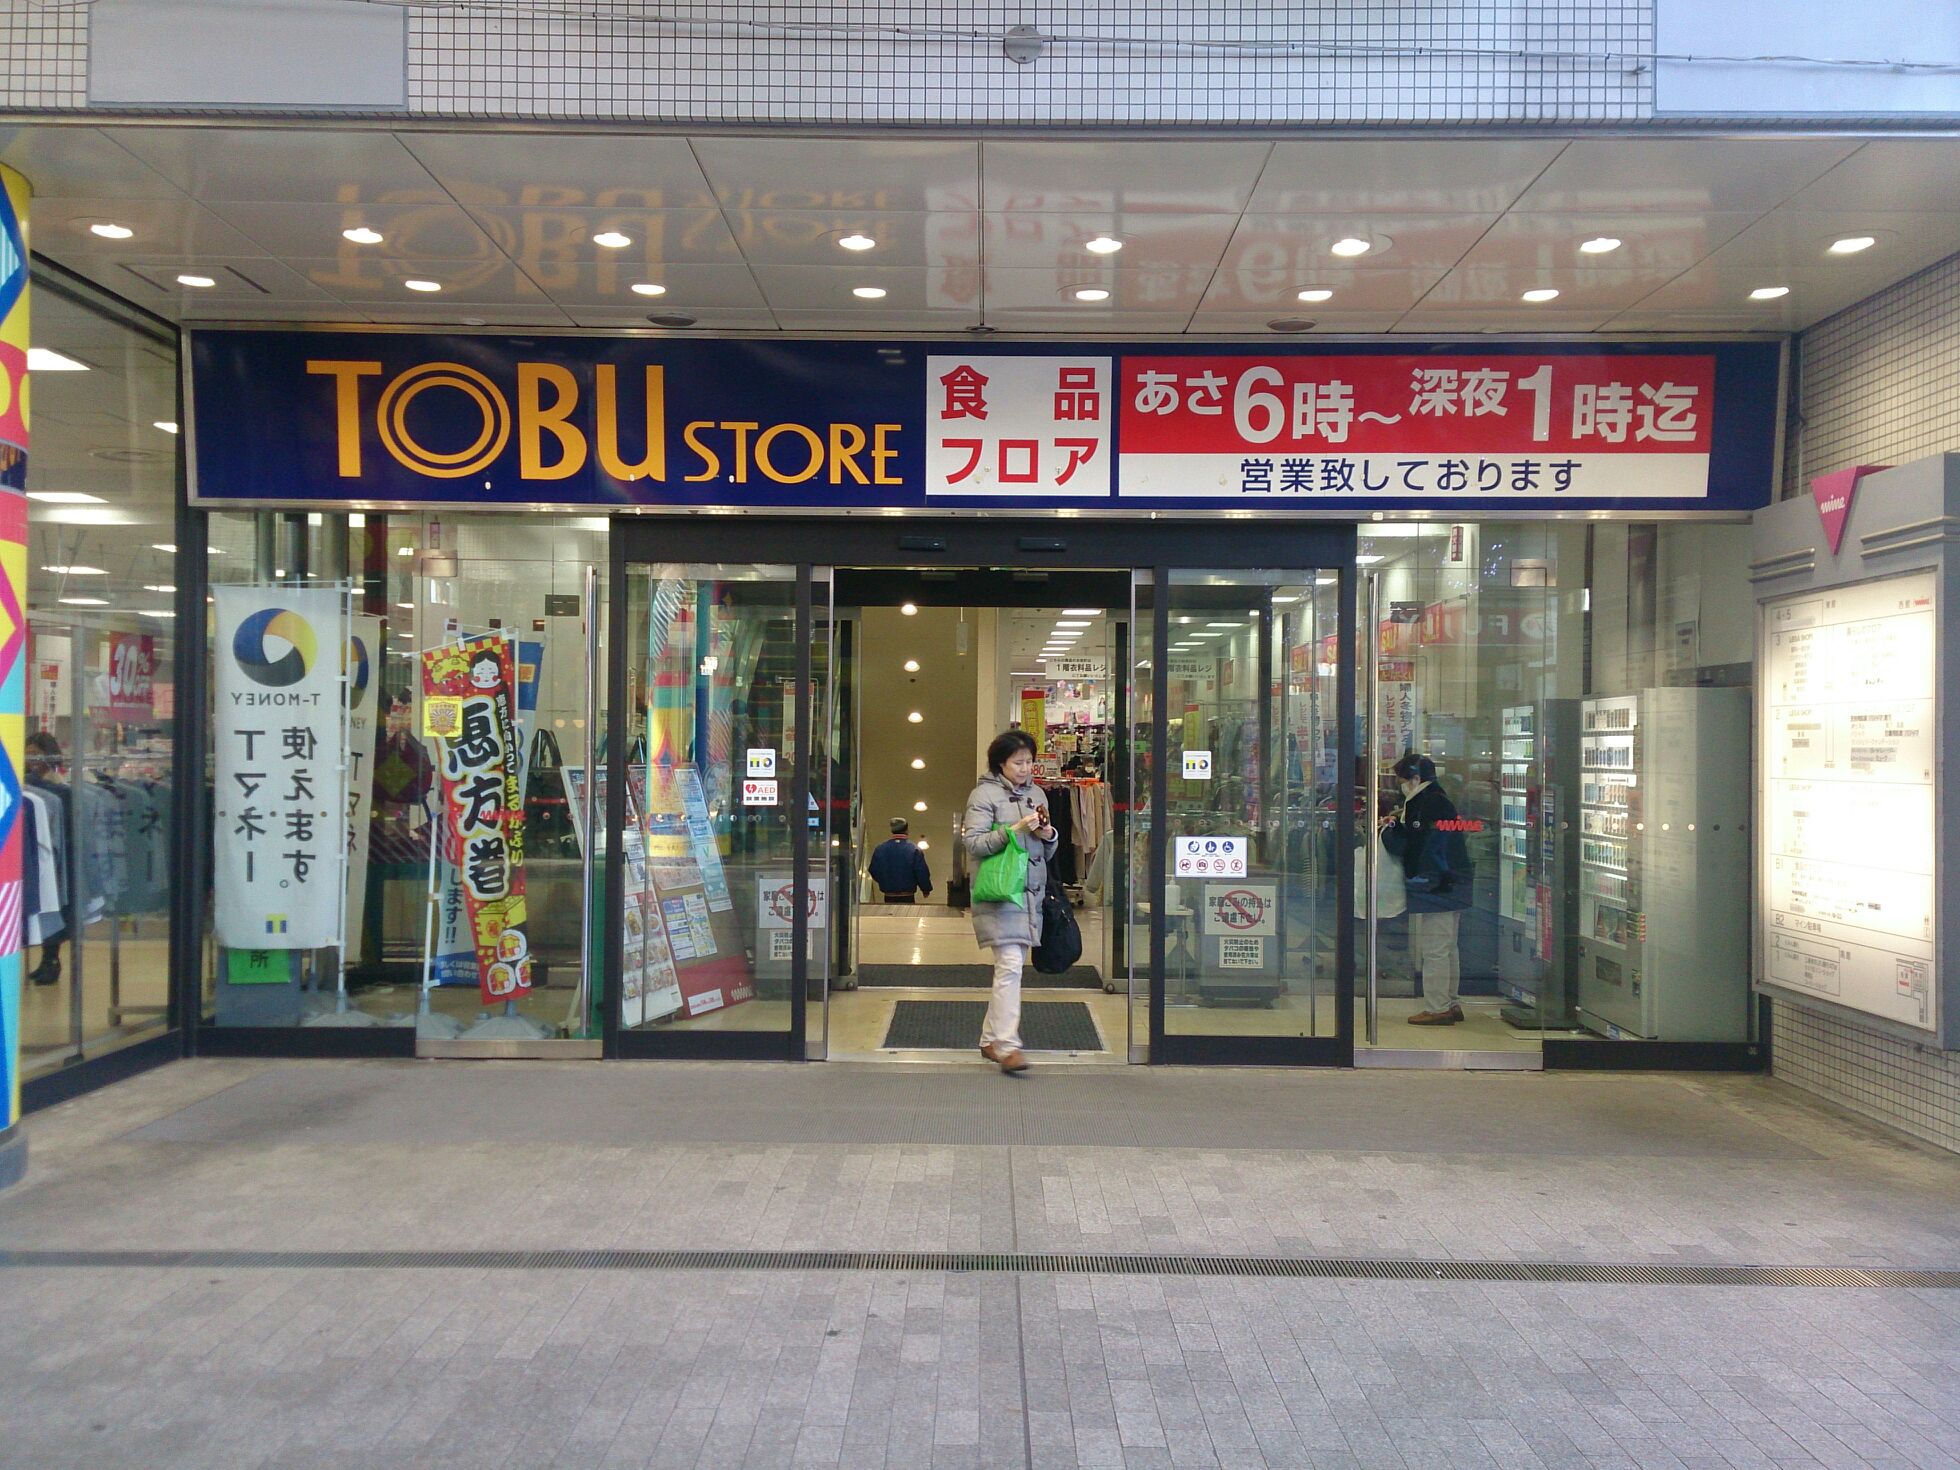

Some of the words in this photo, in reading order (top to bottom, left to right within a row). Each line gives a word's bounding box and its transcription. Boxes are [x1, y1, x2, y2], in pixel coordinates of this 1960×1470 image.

[306, 360, 665, 482] TOBU
[683, 421, 903, 485] STORE
[942, 438, 1099, 486] フロア
[1241, 458, 1581, 492] 営業致しております
